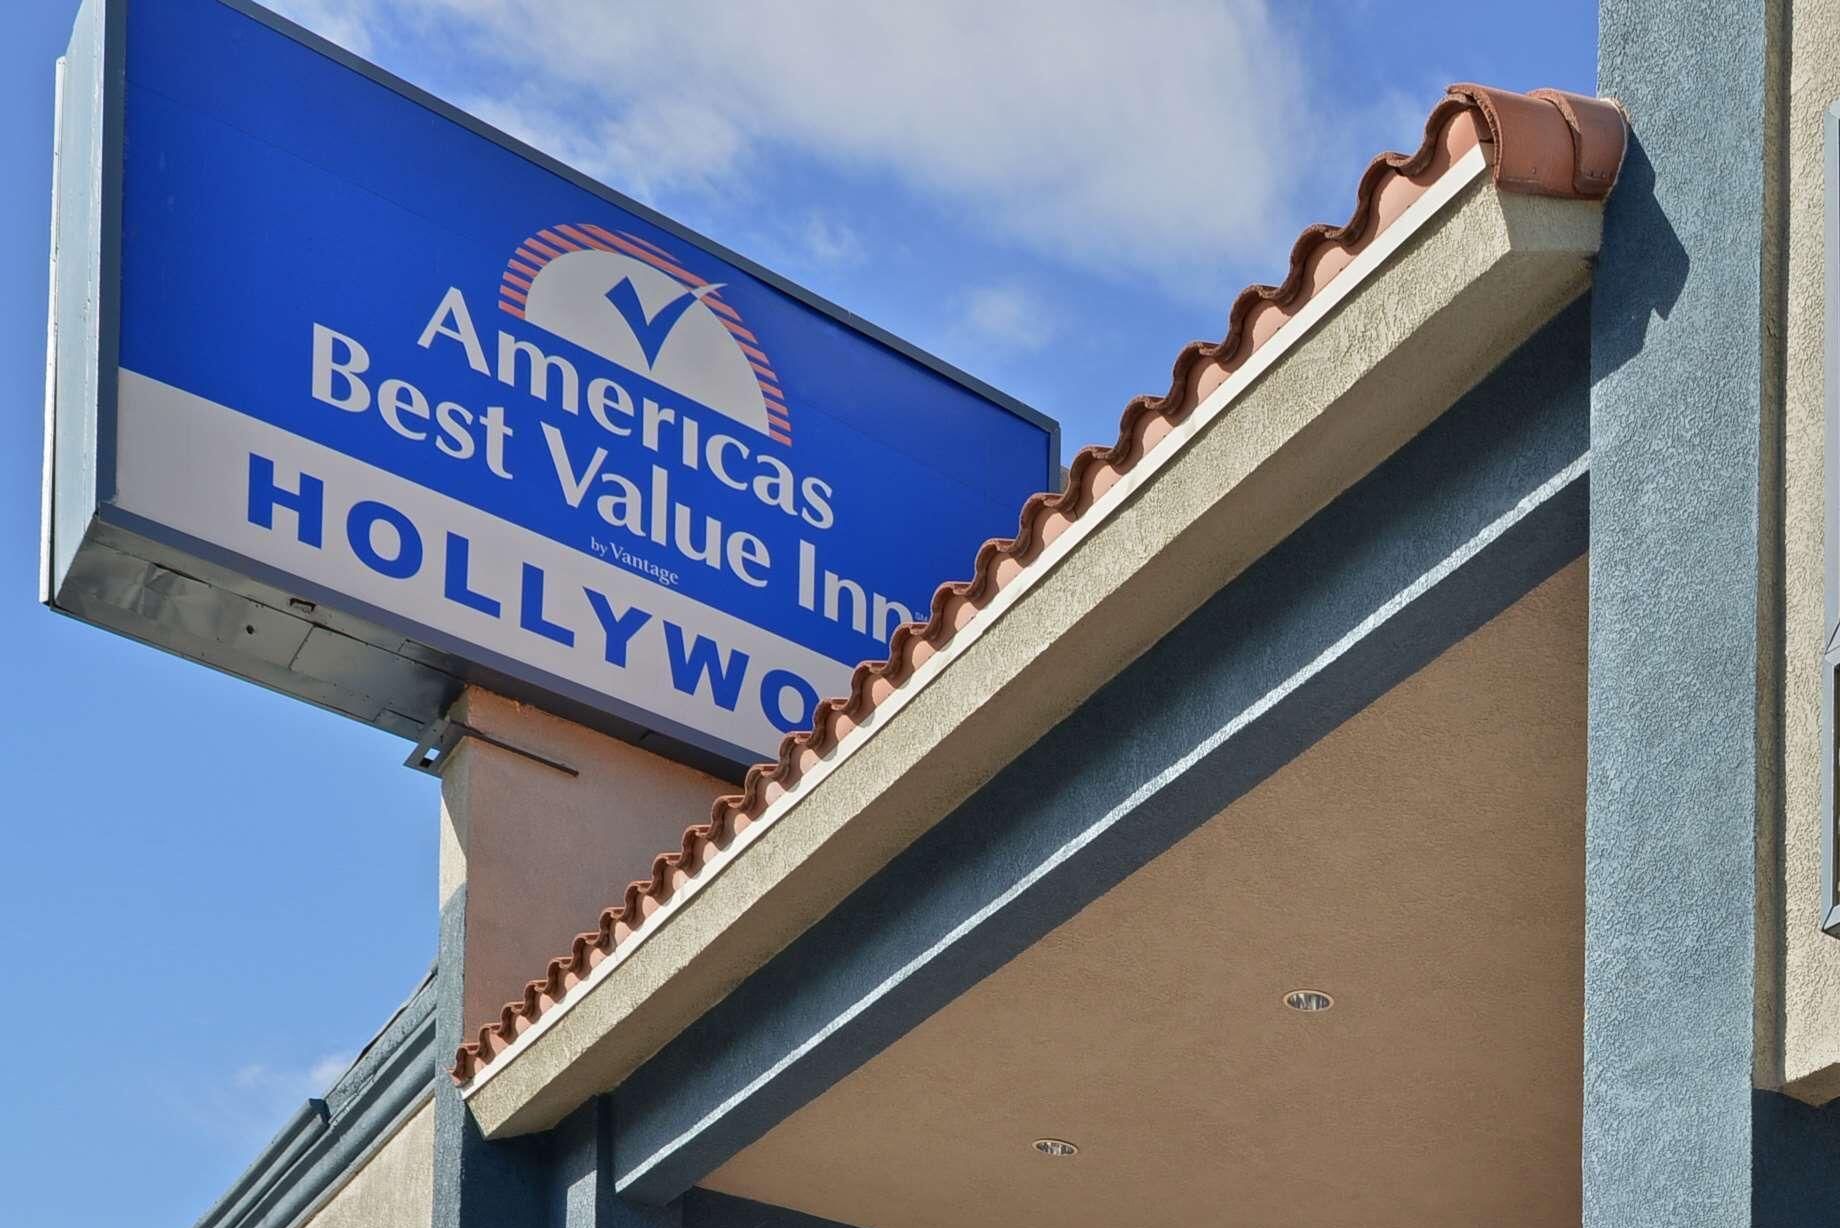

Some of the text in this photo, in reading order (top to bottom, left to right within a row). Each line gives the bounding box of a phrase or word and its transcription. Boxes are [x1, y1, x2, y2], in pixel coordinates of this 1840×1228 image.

[312, 322, 914, 644] Best Value Inn
[417, 286, 834, 529] Americas
[590, 536, 680, 586] by Vantage
